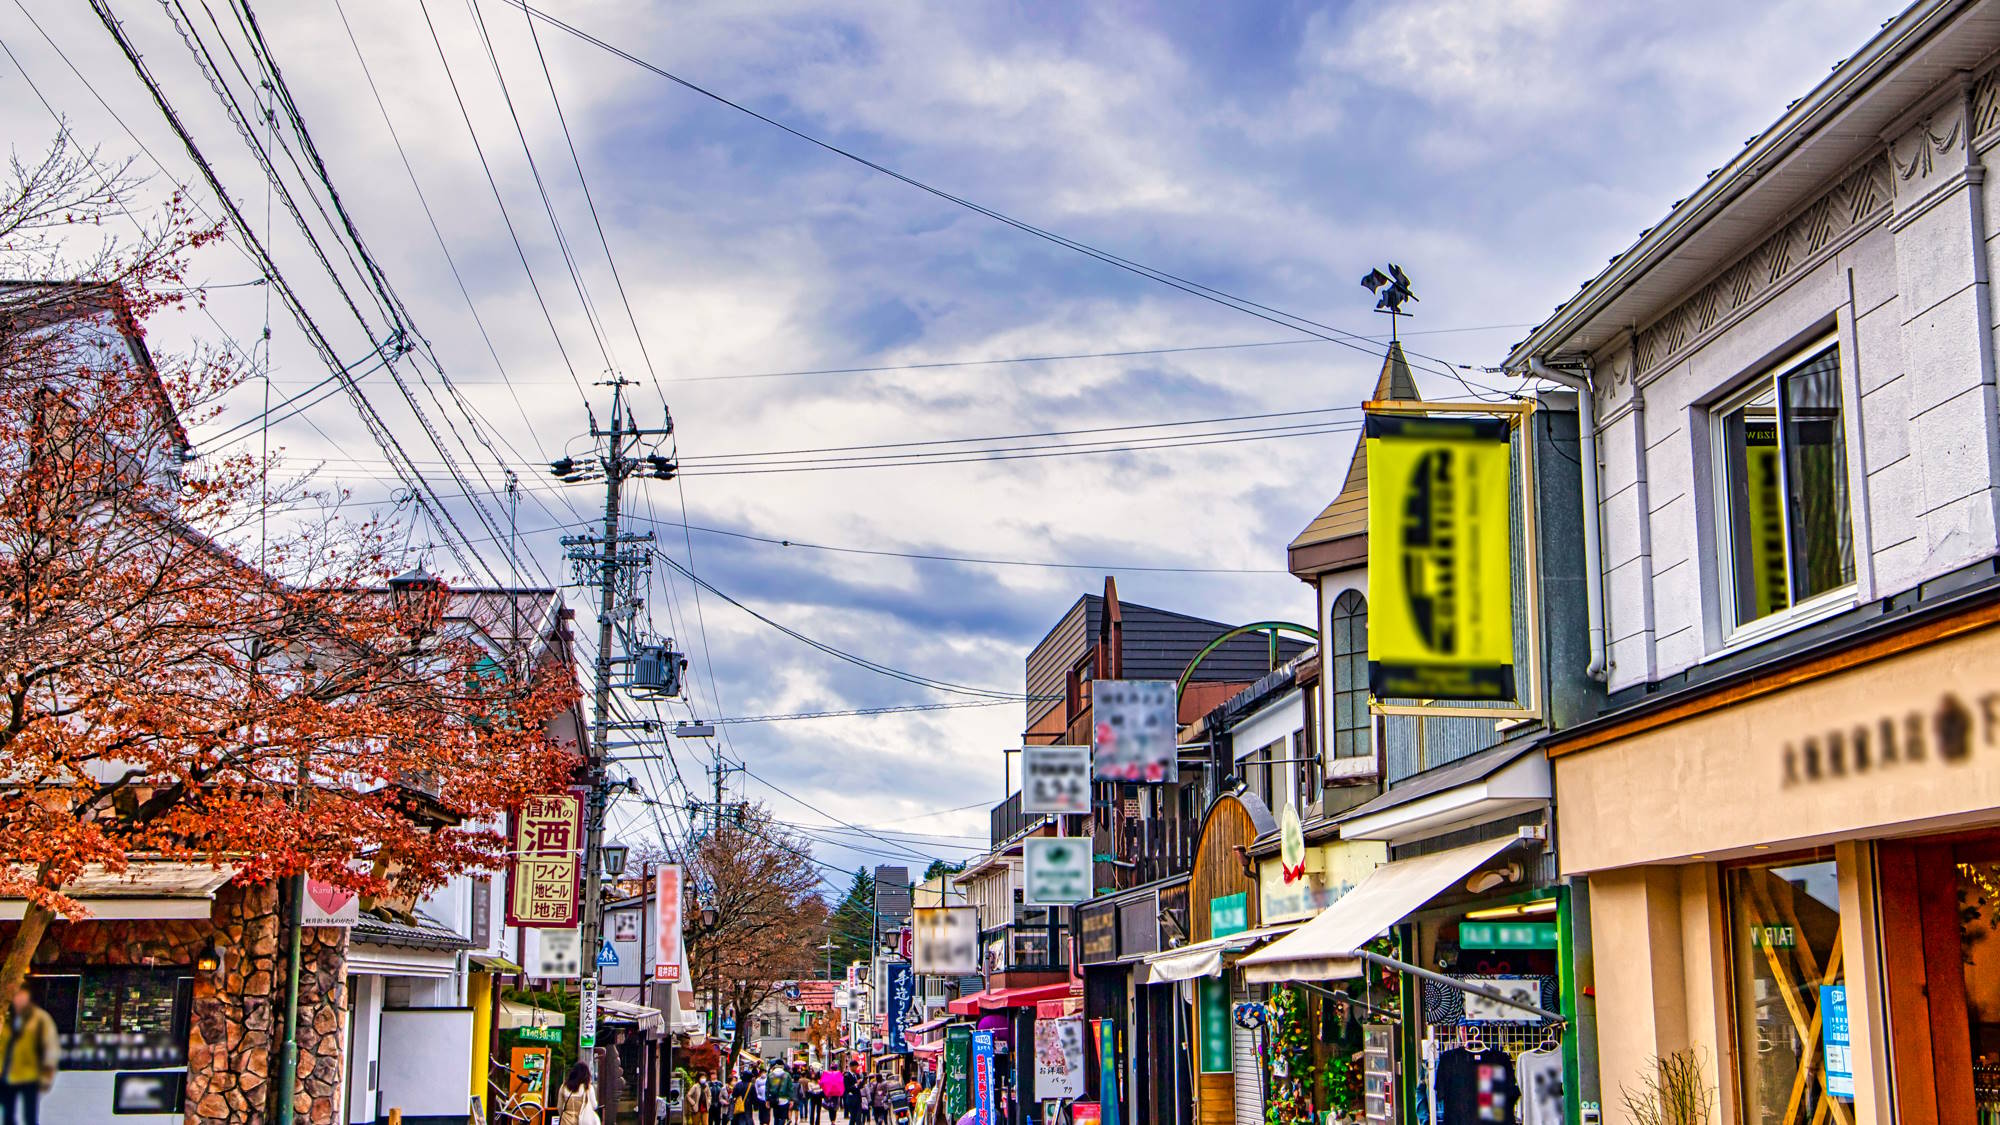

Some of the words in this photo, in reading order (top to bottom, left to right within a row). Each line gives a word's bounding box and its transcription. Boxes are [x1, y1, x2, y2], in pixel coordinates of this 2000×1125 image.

[526, 799, 573, 818] 信州の
[524, 820, 571, 858] 酒
[536, 864, 570, 879] ワイン
[535, 883, 569, 898] 地ビール
[534, 902, 568, 918] 地酒
[657, 966, 678, 977] 軽井沢店
[585, 991, 593, 1021] 黒うどん
[1040, 1066, 1065, 1075] お洋服
